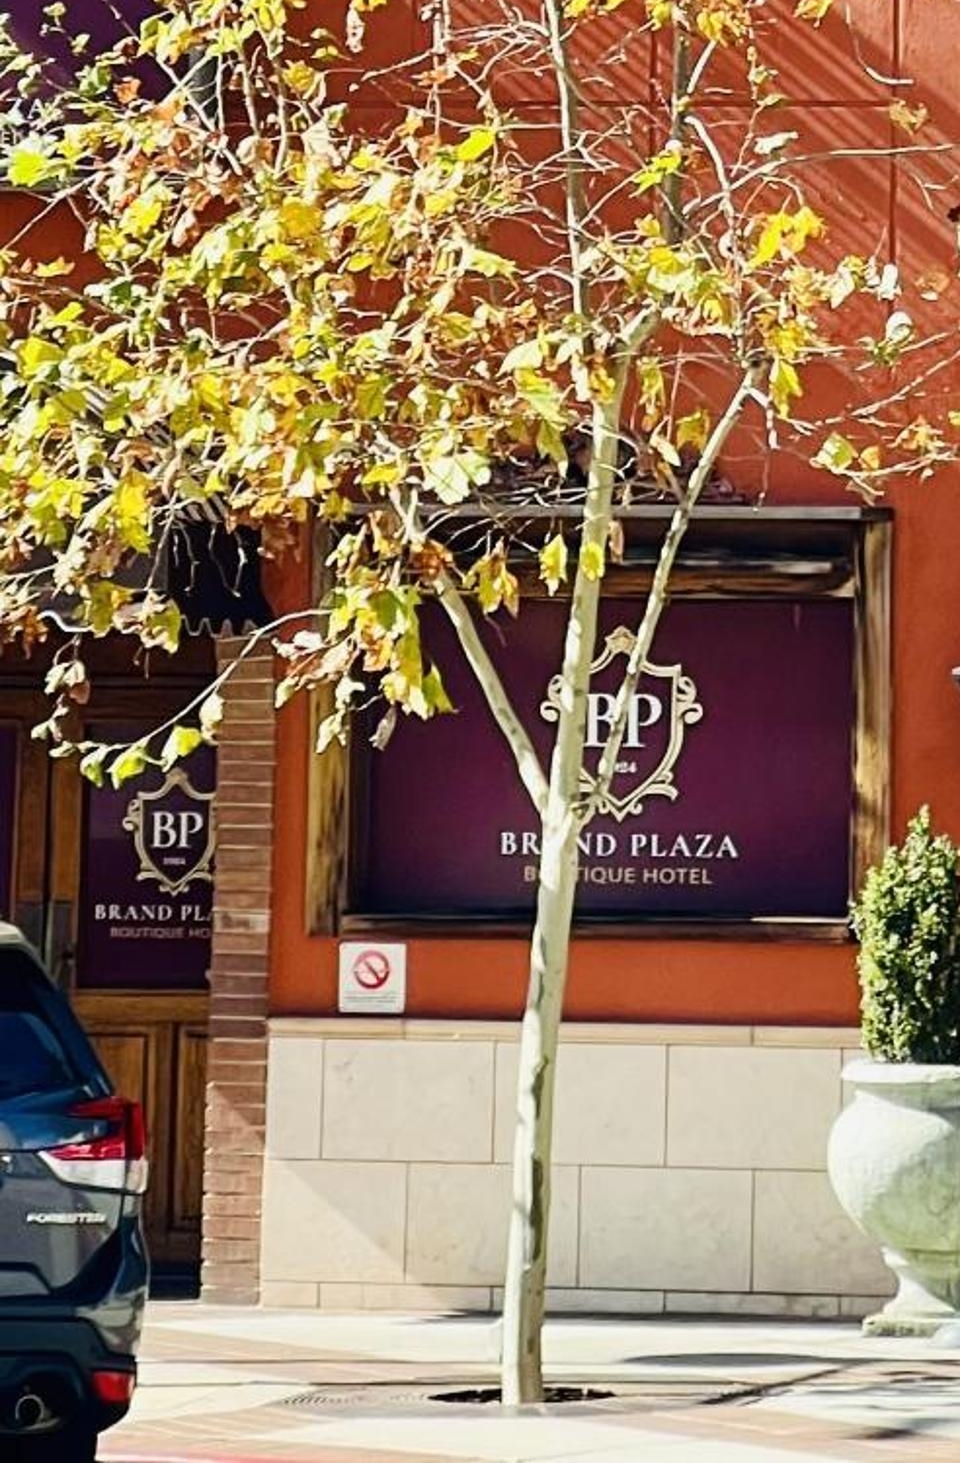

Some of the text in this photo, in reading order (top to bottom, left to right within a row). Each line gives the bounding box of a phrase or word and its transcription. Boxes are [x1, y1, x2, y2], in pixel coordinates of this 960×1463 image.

[151, 811, 204, 848] BP
[501, 832, 739, 858] BRND PLAZA
[523, 866, 713, 884] BIQUE HOTEL
[95, 904, 173, 921] BRAND
